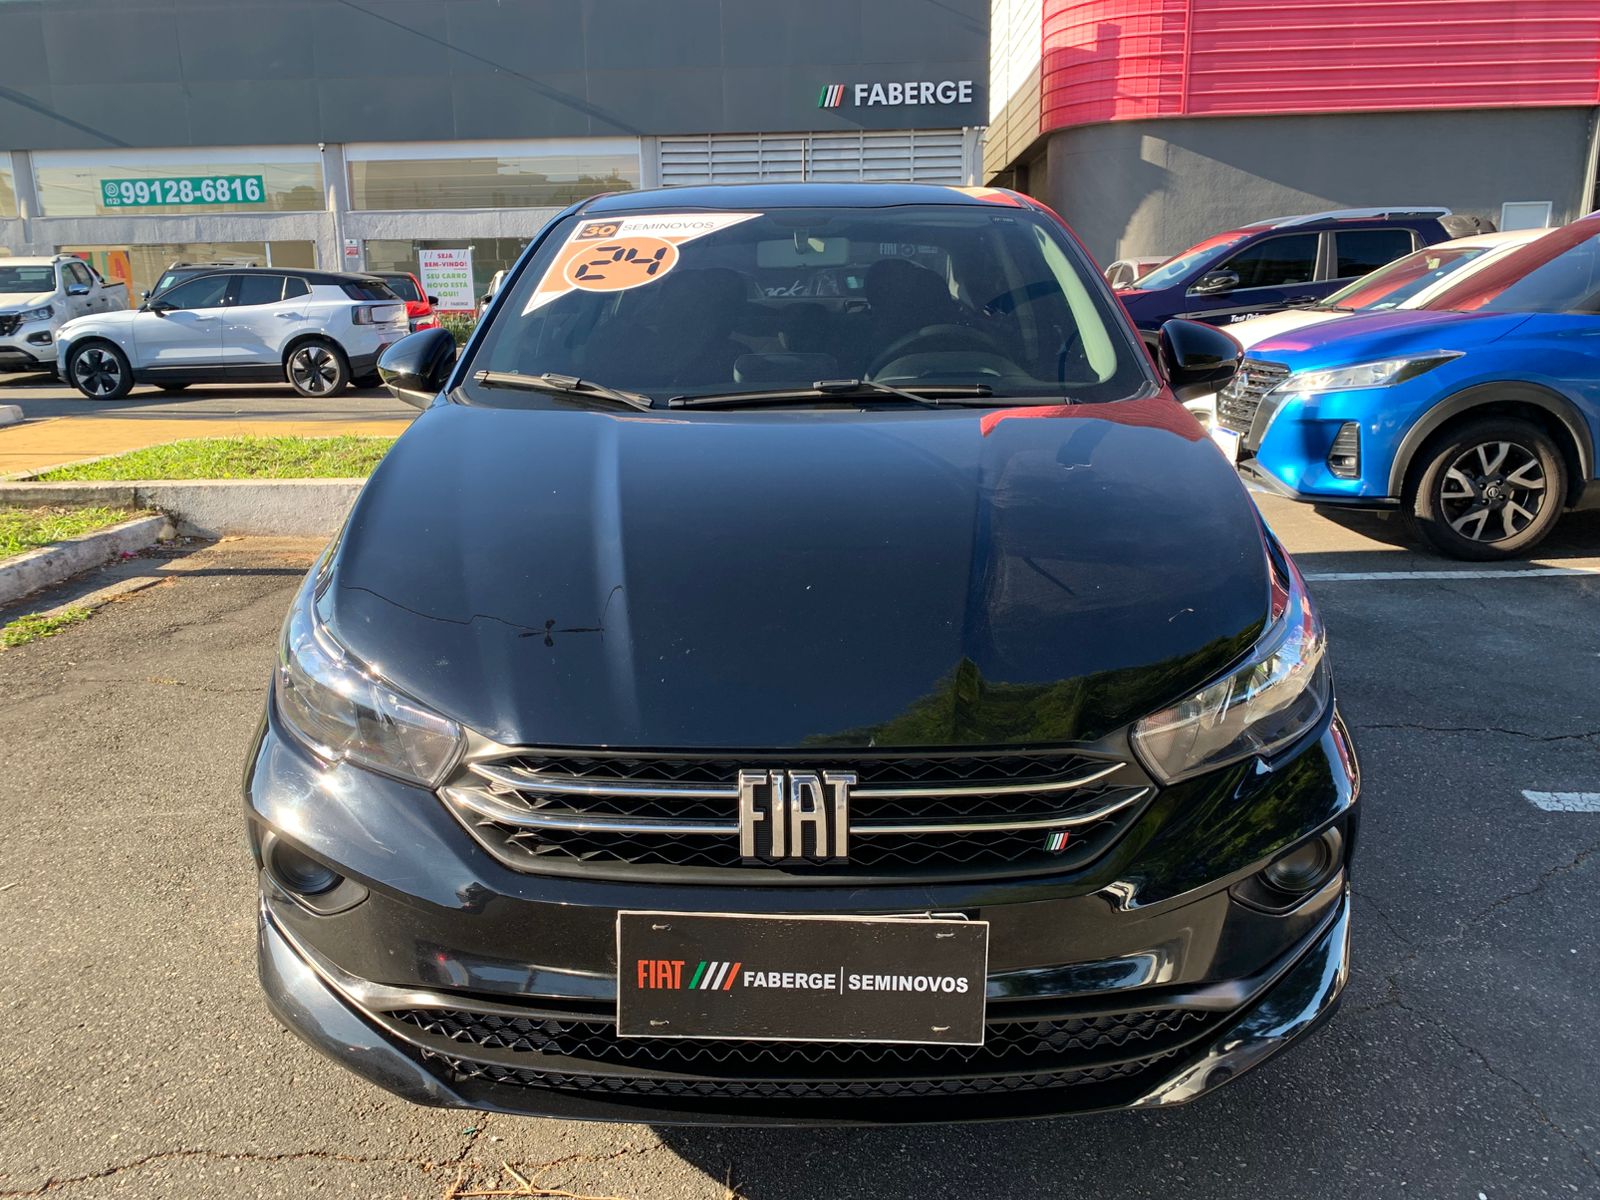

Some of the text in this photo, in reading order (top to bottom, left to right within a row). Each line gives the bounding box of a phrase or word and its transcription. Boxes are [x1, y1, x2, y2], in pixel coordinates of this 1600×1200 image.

[854, 80, 973, 106] FABERGE
[120, 177, 261, 204] 99128-6816
[622, 221, 715, 231] SEMINOVOS
[574, 246, 668, 281] 24
[1230, 313, 1246, 323] Test
[739, 769, 859, 858] FIAT
[637, 959, 969, 994] FIAT FABERGE SEMINOVOS
